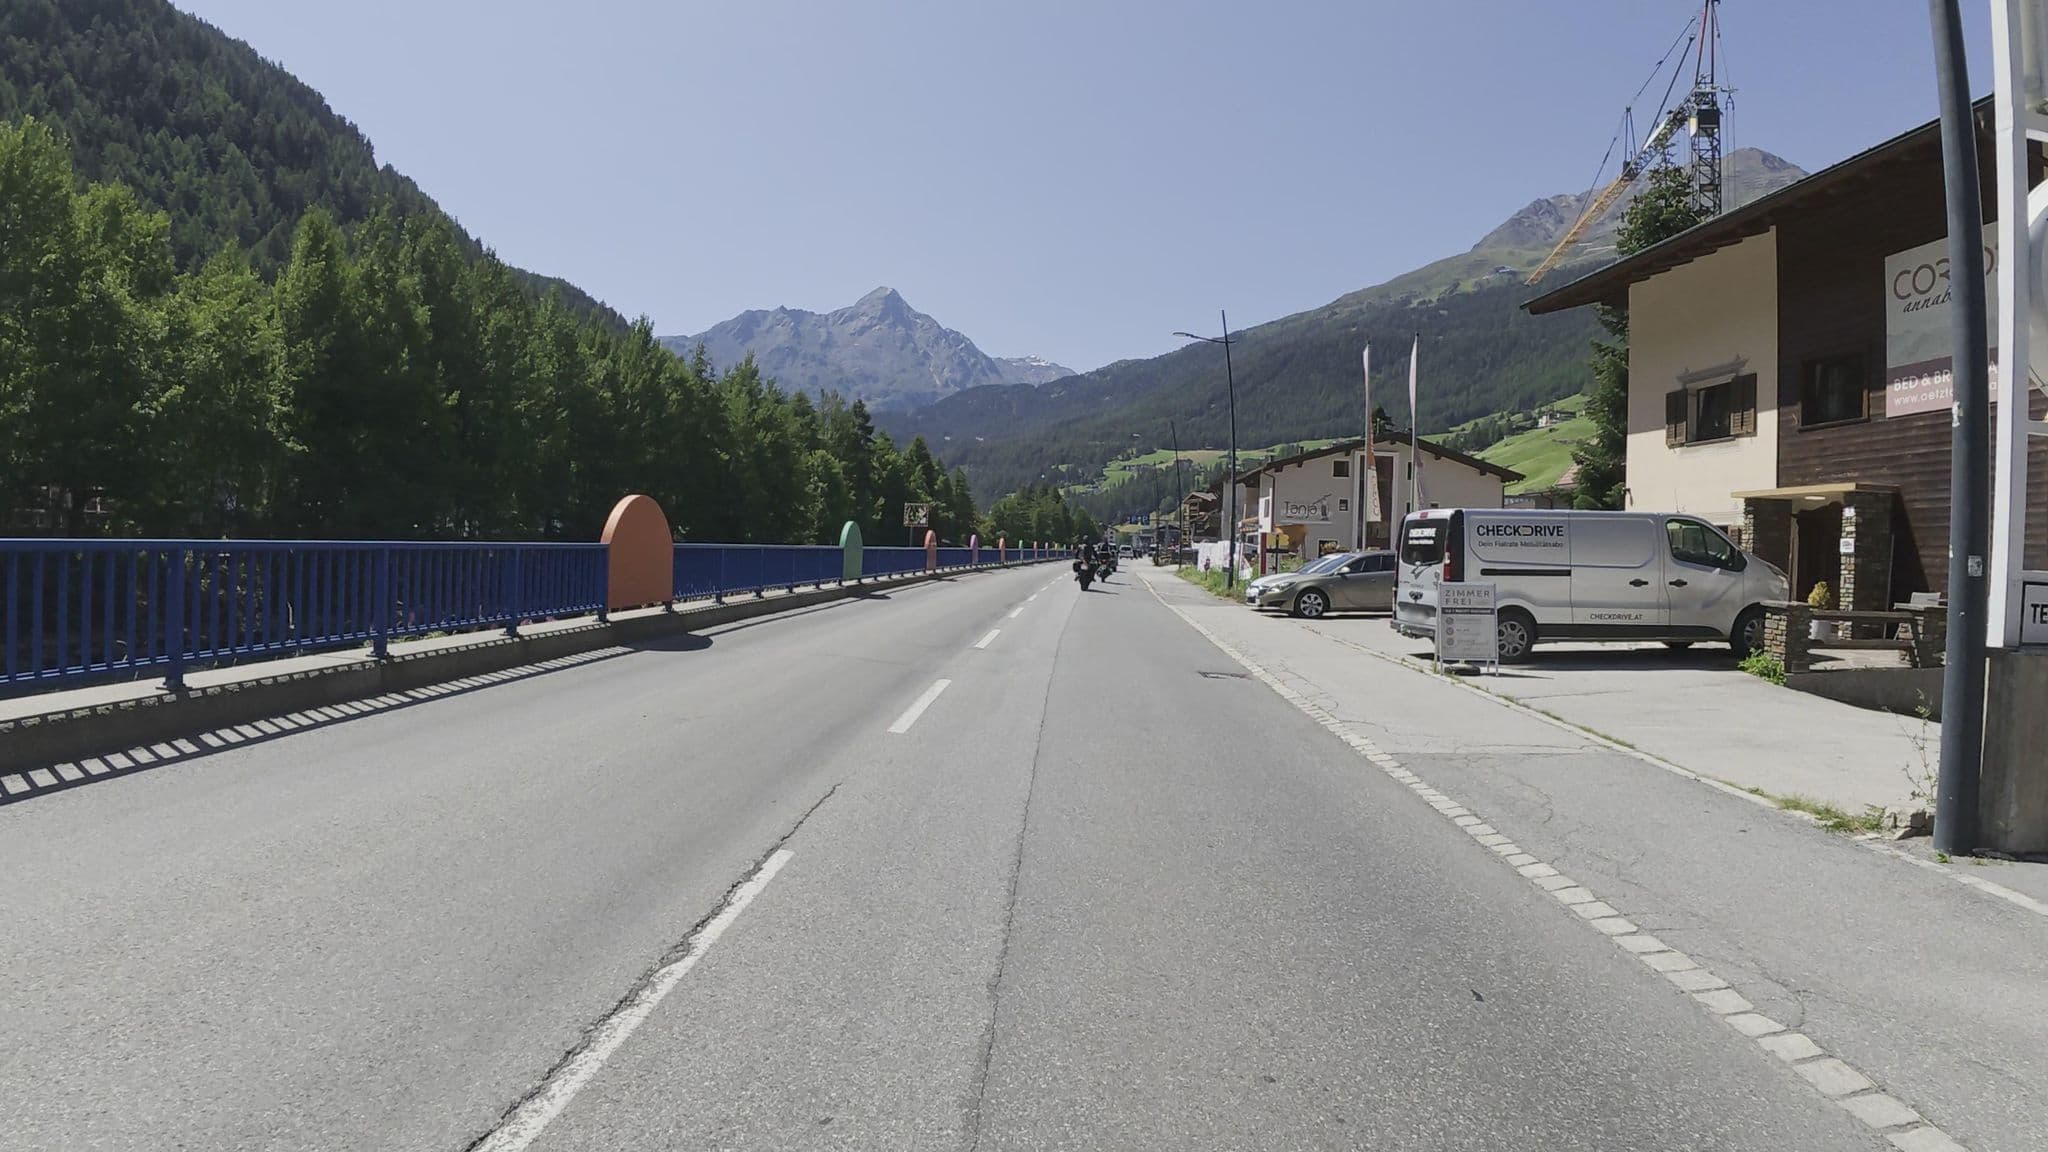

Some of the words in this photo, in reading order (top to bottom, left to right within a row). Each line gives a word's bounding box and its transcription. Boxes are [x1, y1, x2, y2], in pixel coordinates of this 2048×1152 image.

[1893, 376, 1919, 392] BED
[1921, 373, 1931, 386] &
[1283, 501, 1317, 519] Tanja
[1476, 524, 1564, 537] CHECKDRIVE
[1445, 589, 1490, 598] ZIMMER
[1445, 598, 1472, 606] FREI
